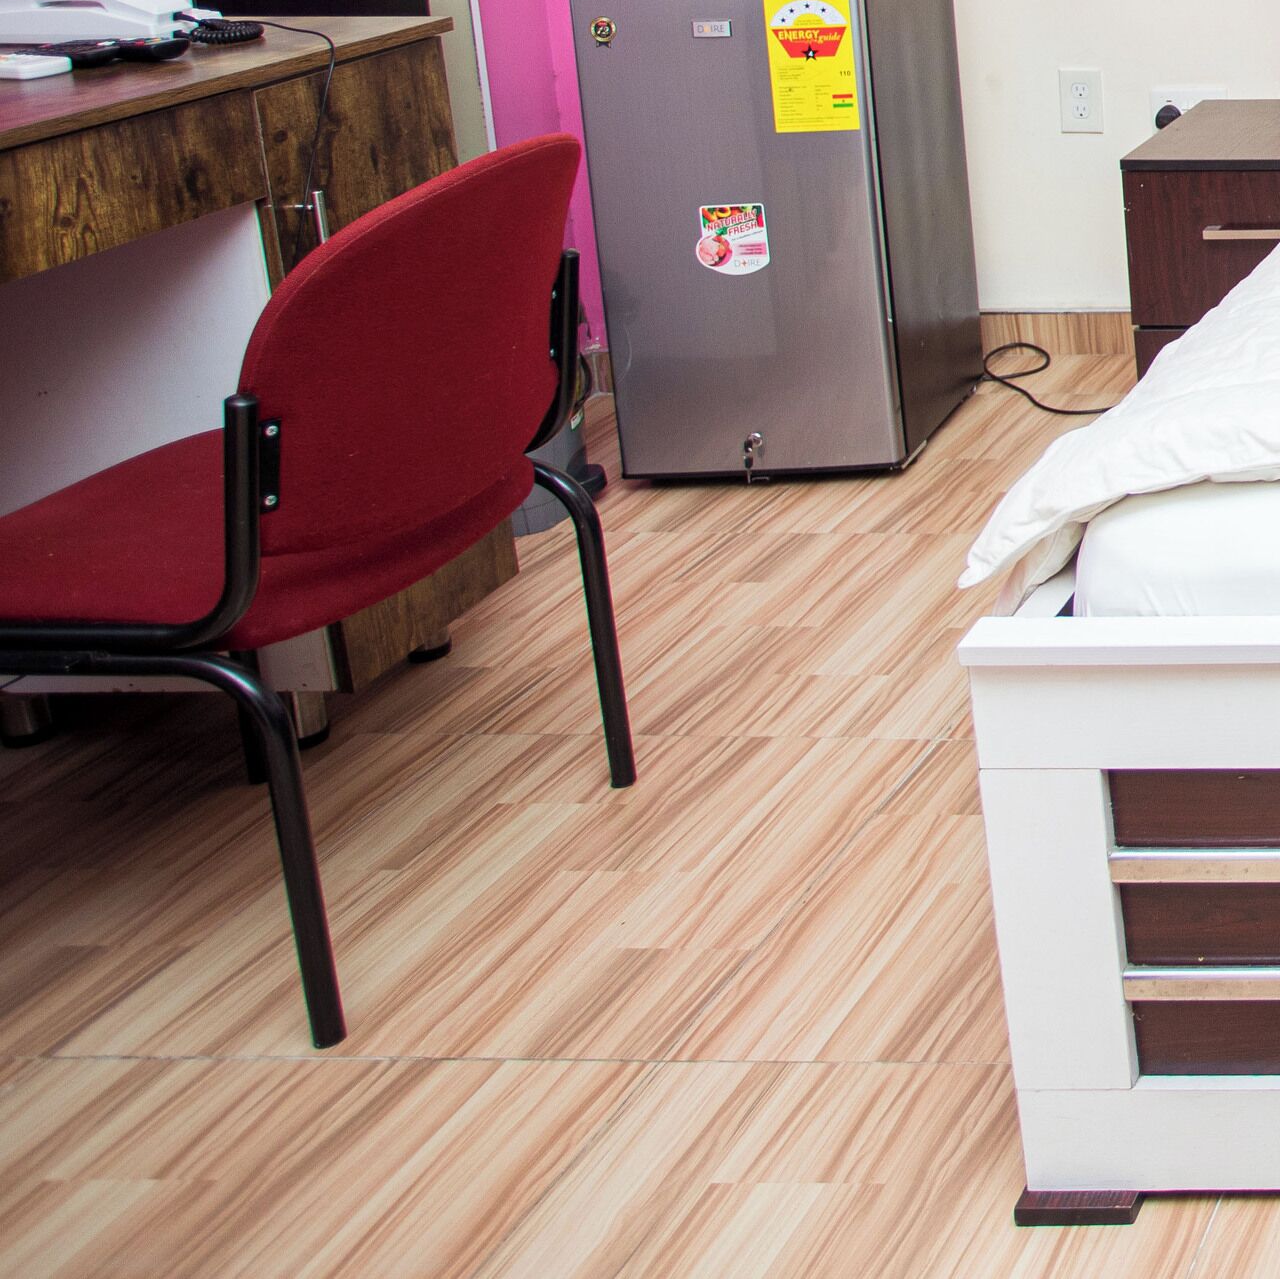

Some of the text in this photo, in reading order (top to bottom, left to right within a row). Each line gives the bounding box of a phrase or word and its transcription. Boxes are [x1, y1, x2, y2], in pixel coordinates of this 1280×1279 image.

[778, 30, 819, 42] ENERGY
[818, 32, 841, 44] guide
[706, 208, 757, 231] NATURALLY
[728, 220, 757, 236] FRESH
